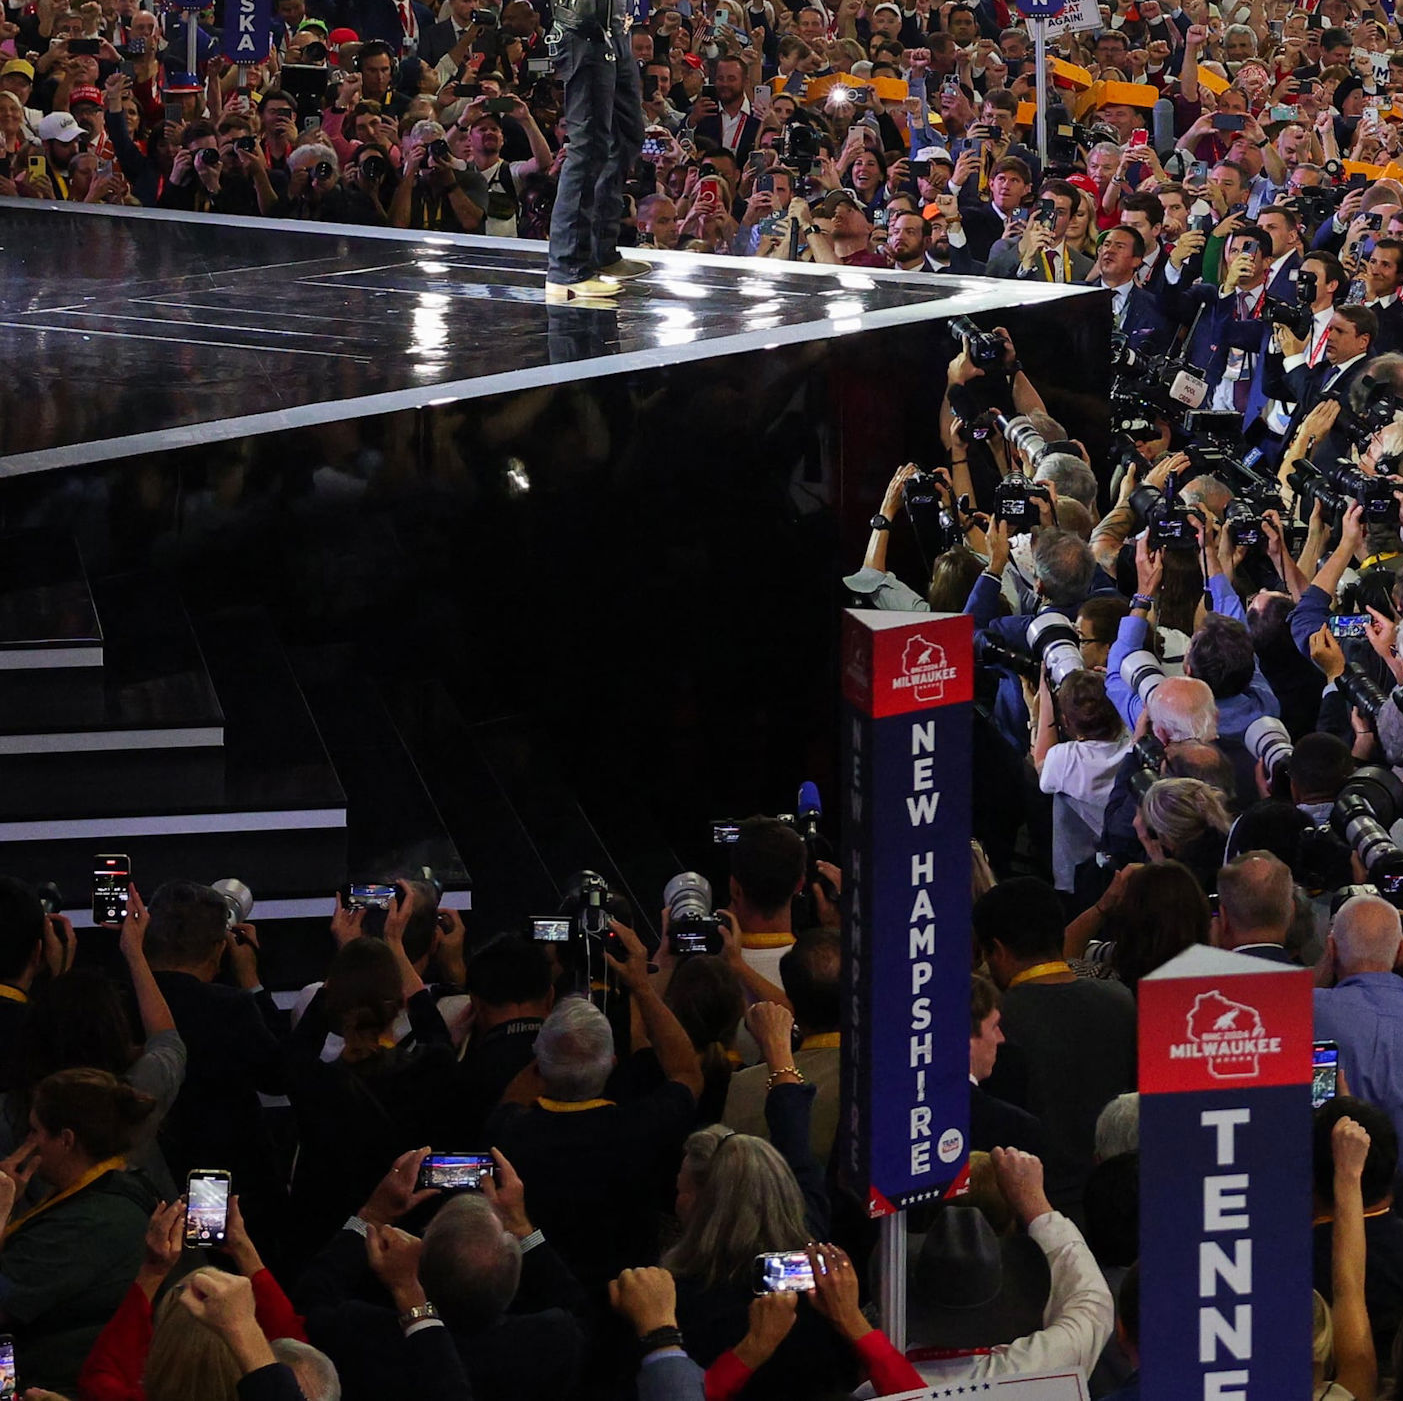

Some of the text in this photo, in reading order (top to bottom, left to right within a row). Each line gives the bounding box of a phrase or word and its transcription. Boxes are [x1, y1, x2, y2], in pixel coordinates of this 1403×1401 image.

[1047, 12, 1084, 28] AGAIN!
[892, 666, 957, 690] MILWAUKEE
[905, 720, 941, 1177] NEW HAMPSHIRE
[1169, 1037, 1281, 1060] MILWAUKEE
[942, 1136, 959, 1147] TEAM
